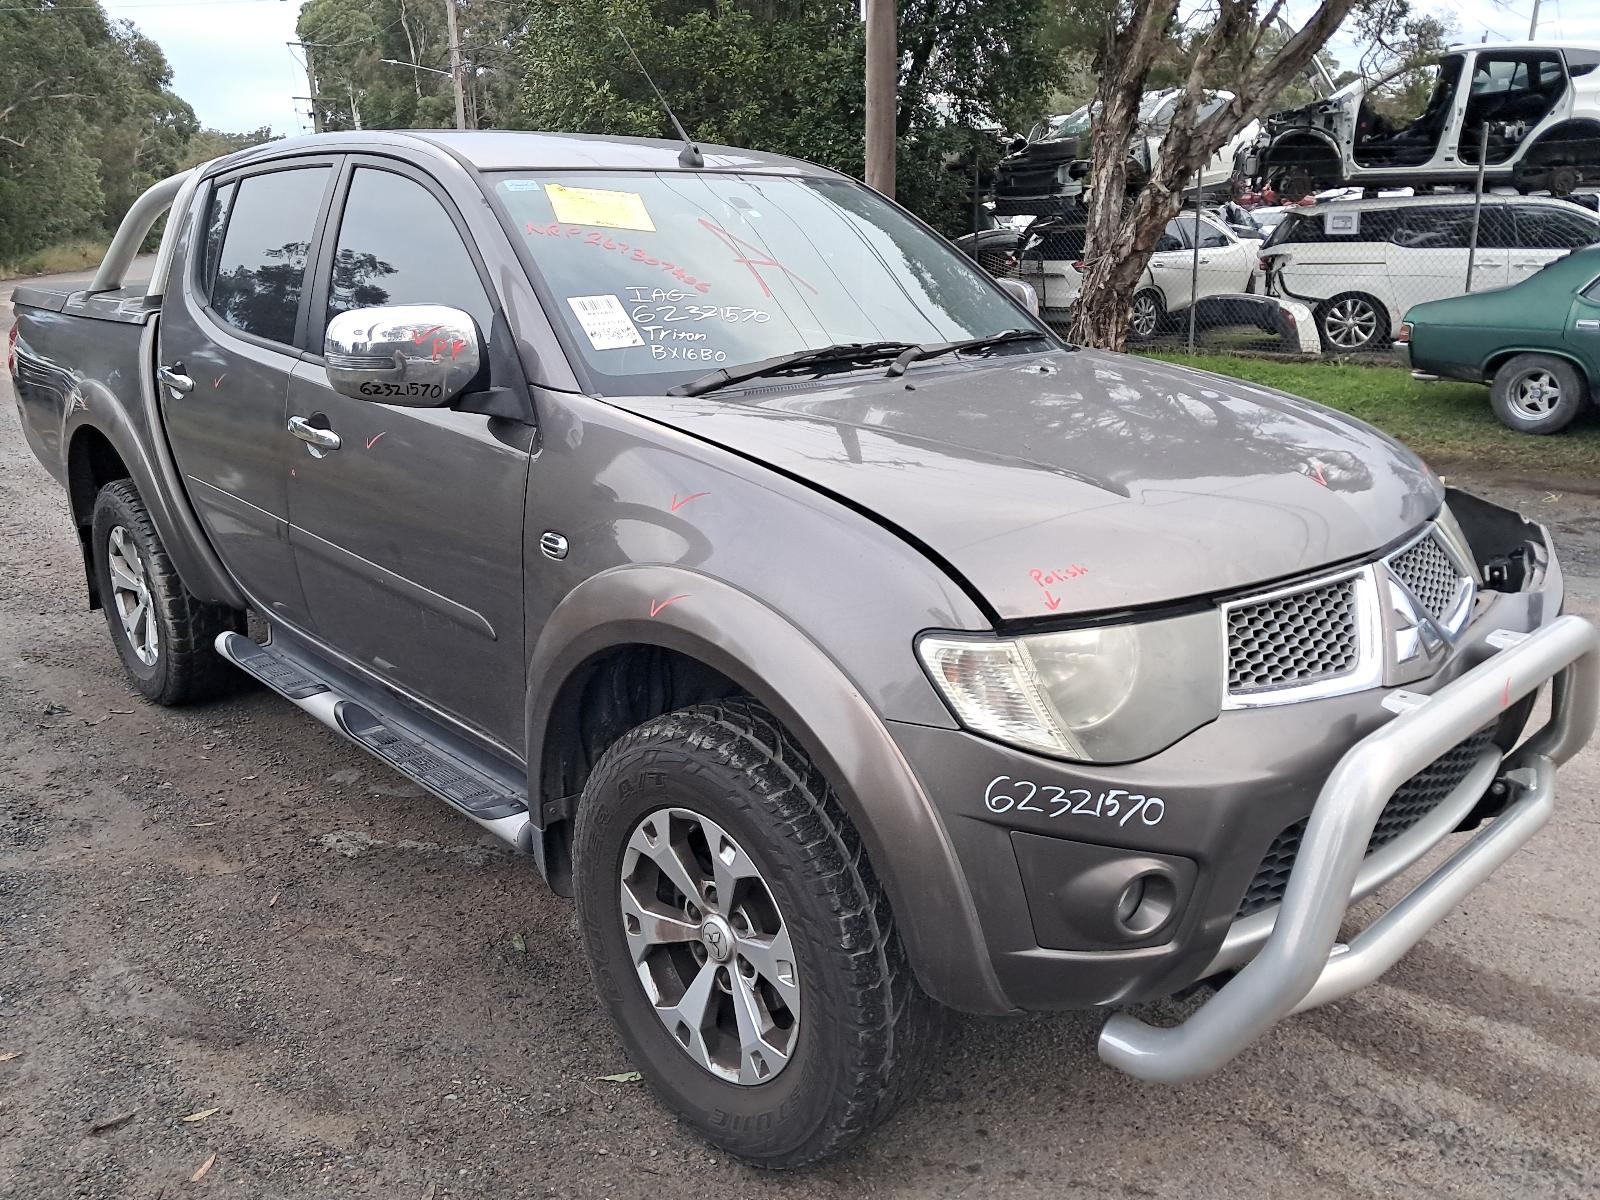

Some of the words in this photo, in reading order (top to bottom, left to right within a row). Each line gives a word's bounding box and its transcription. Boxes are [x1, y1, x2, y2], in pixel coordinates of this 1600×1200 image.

[625, 286, 697, 303] IAG
[632, 305, 771, 323] 62321570
[640, 325, 707, 341] Triton
[359, 381, 442, 398] 62321570
[1028, 563, 1089, 588] Polish
[984, 775, 1165, 827] 62321570
